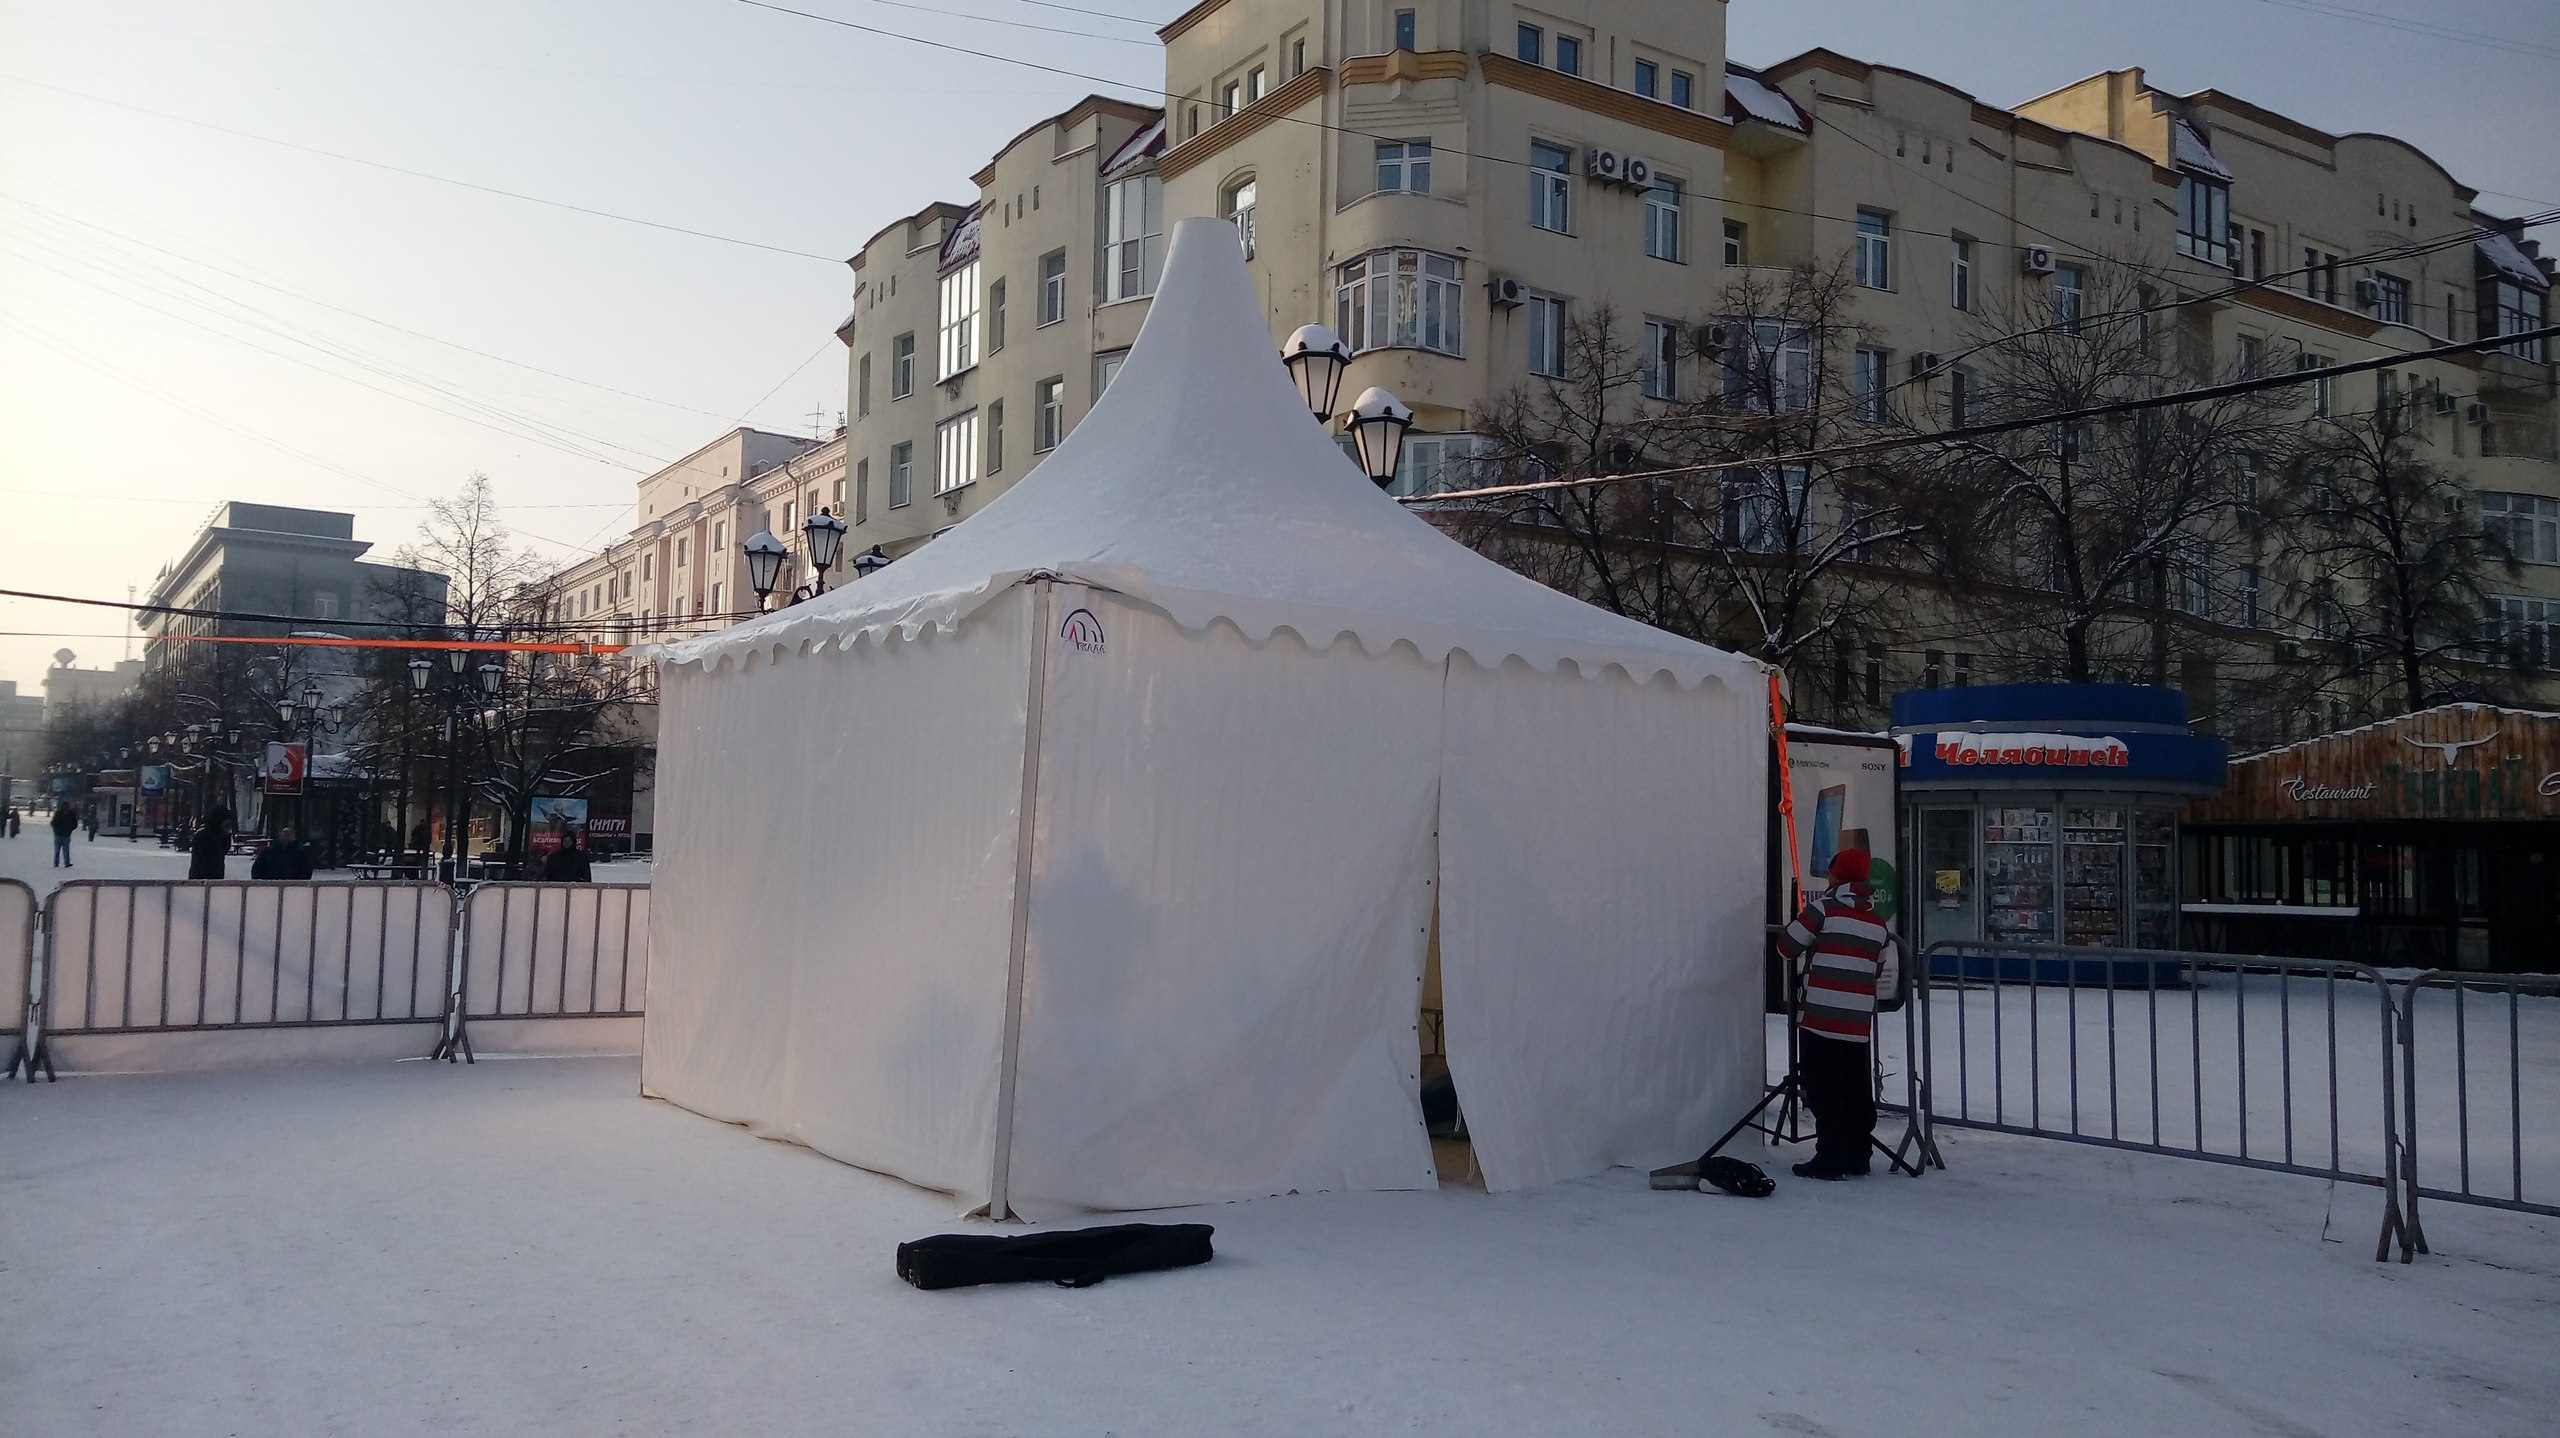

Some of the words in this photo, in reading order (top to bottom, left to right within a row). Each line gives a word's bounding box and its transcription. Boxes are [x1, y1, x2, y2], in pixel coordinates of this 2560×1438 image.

[1935, 742, 2129, 766] Челябинск
[1861, 762, 1886, 771] SONY
[2280, 775, 2377, 801] Restaurant
